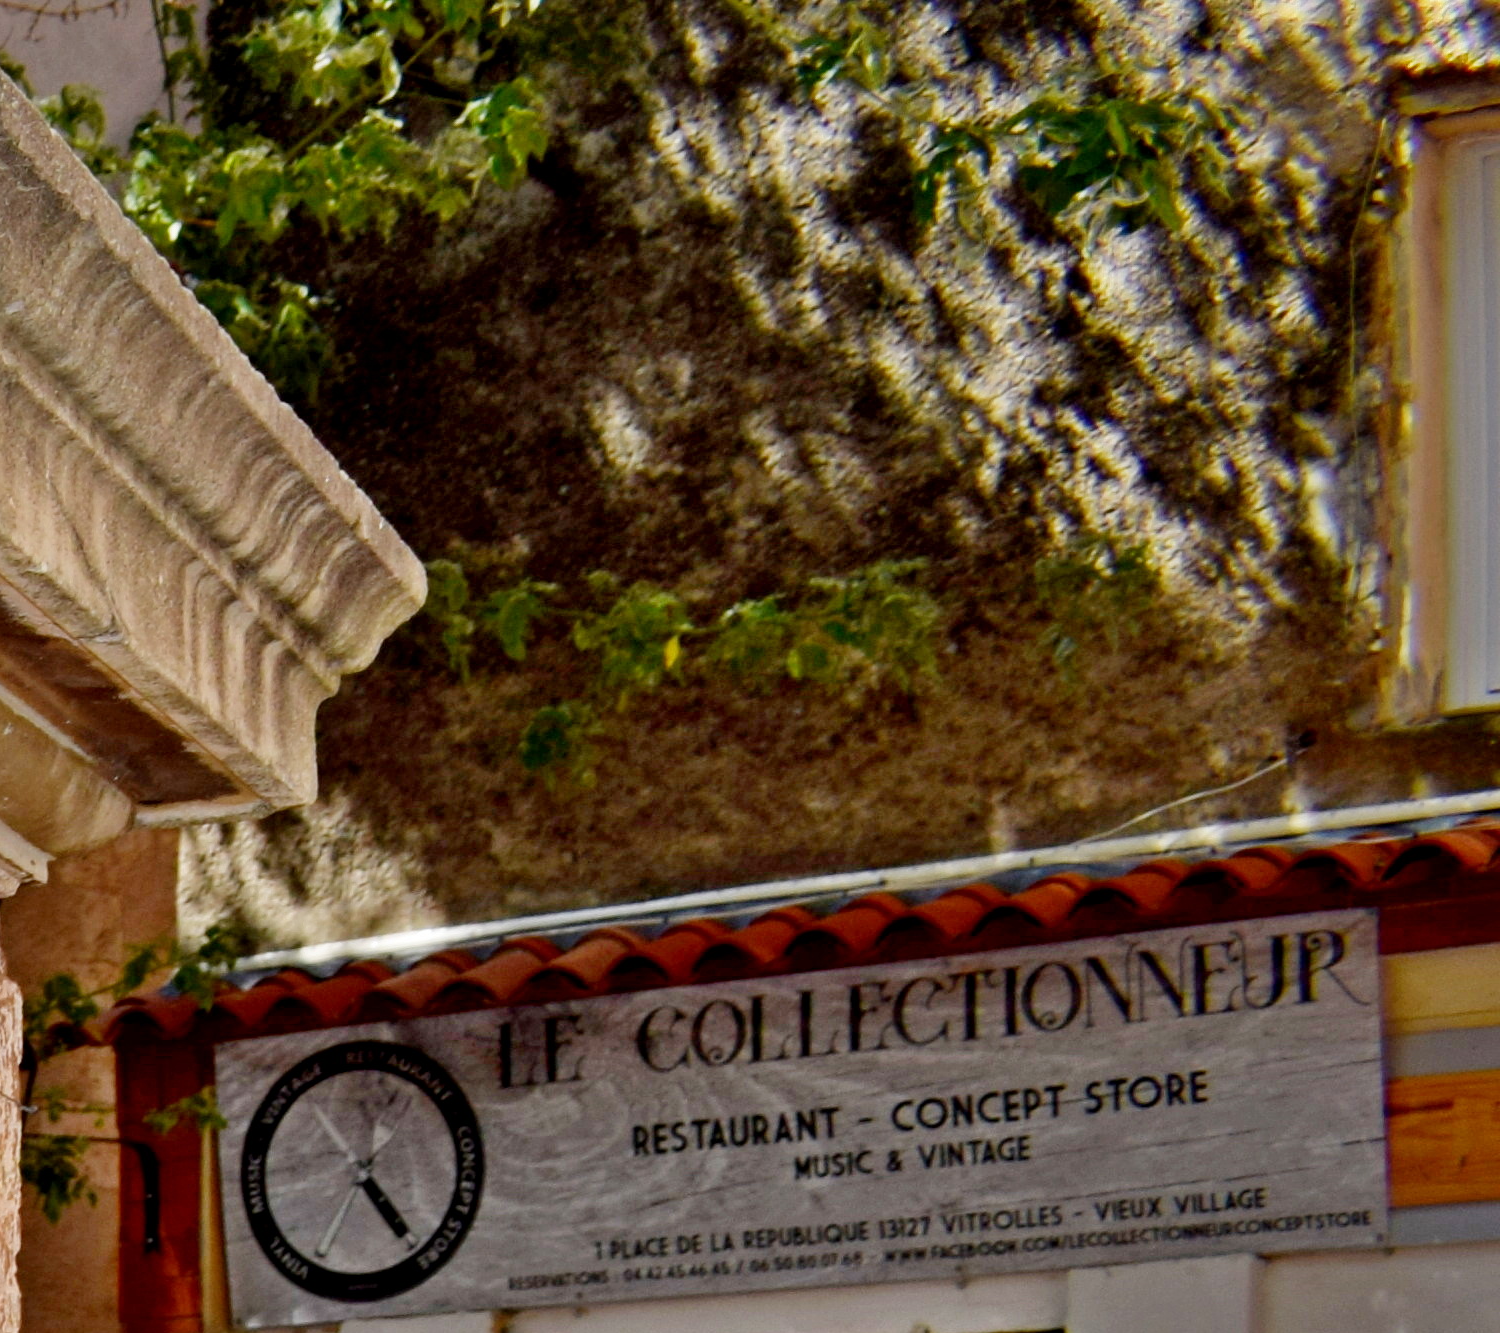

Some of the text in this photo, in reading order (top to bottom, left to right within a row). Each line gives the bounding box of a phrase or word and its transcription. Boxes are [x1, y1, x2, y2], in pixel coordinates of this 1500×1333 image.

[499, 929, 1370, 1088] LE COLLECTIONNEUR
[632, 1106, 840, 1157] RESTAURANT
[891, 1084, 1066, 1132] CONCEPT
[1084, 1070, 1209, 1114] STORE
[248, 1154, 265, 1214] MUSIC
[795, 1135, 1032, 1180] MUSIC & VINTAGE
[416, 1125, 477, 1270] CONCEPT STORE
[609, 1236, 668, 1260] PLACE
[676, 1233, 702, 1254] DE
[710, 1232, 735, 1252] LA
[742, 1220, 869, 1249] REPUBLIQUE
[878, 1215, 931, 1240] 13127
[940, 1204, 1063, 1235] VITROLLES
[1093, 1196, 1163, 1222] VIEUX
[1173, 1187, 1267, 1214] VILLAGE
[269, 1236, 309, 1280] VINYL
